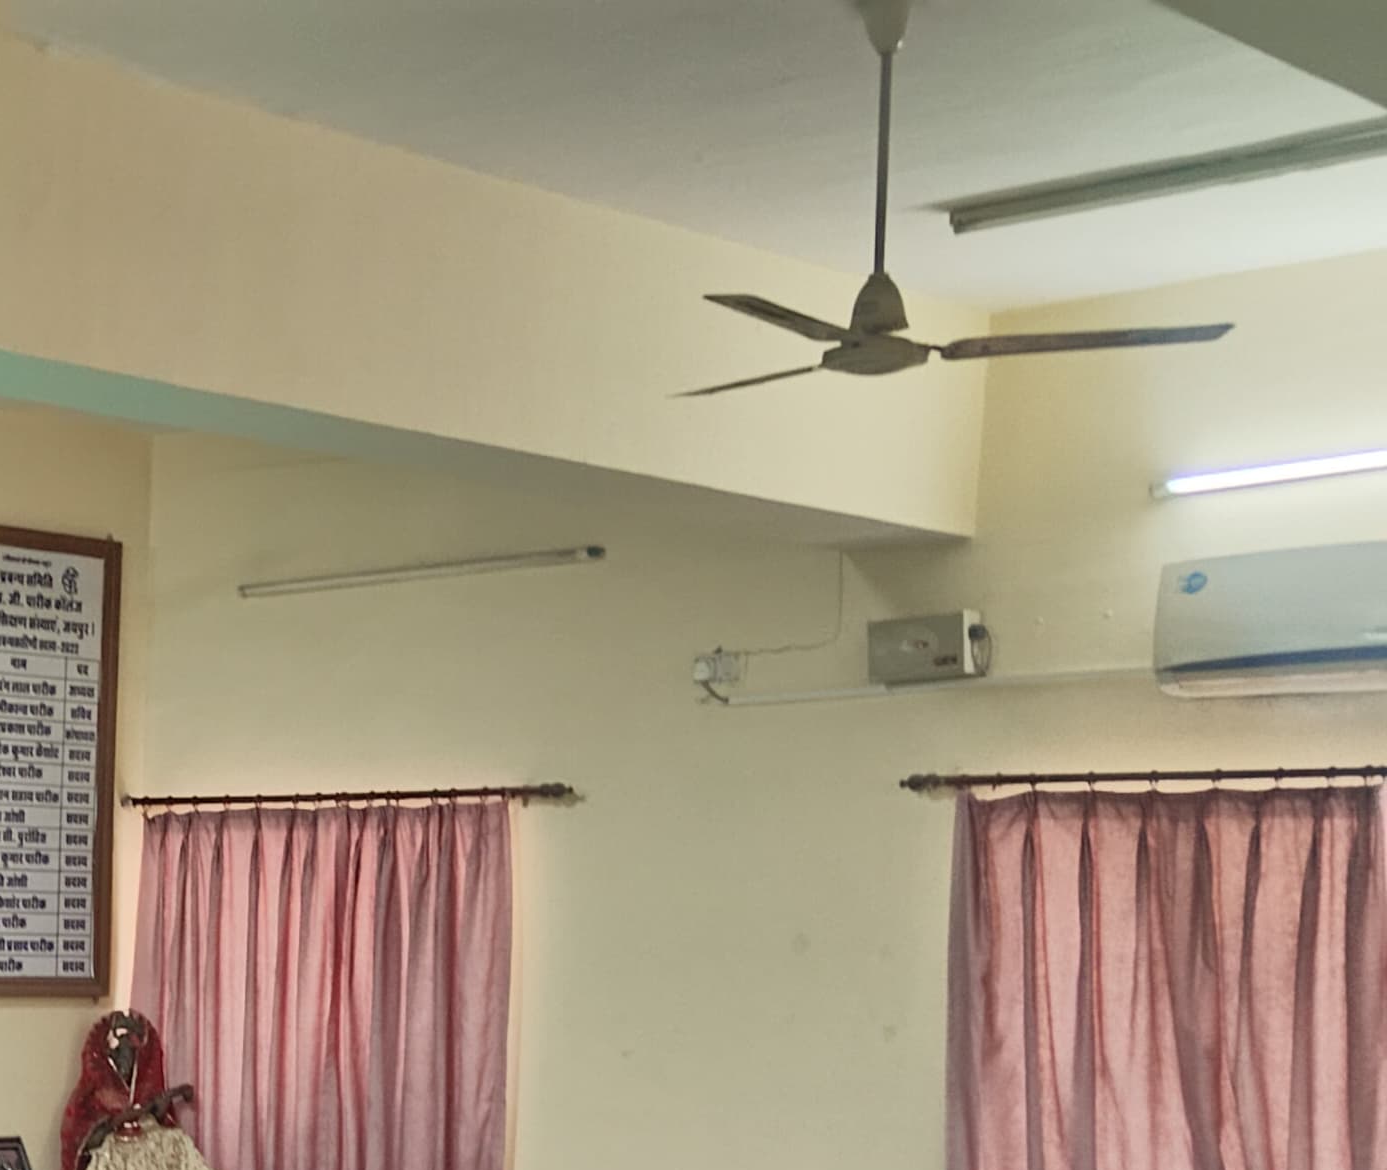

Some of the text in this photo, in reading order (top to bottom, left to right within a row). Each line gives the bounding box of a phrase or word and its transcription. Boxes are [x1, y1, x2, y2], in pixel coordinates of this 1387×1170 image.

[26, 592, 52, 609] पारीक
[32, 681, 56, 695] पारीक
[30, 702, 54, 717] पारीक
[27, 720, 51, 736] पारीक
[18, 764, 42, 778] पारीक
[35, 789, 59, 803] पारीक
[25, 851, 49, 864] पारीक
[22, 895, 46, 909] पारीक
[2, 914, 26, 928] पारीक
[30, 938, 54, 952] पारीक
